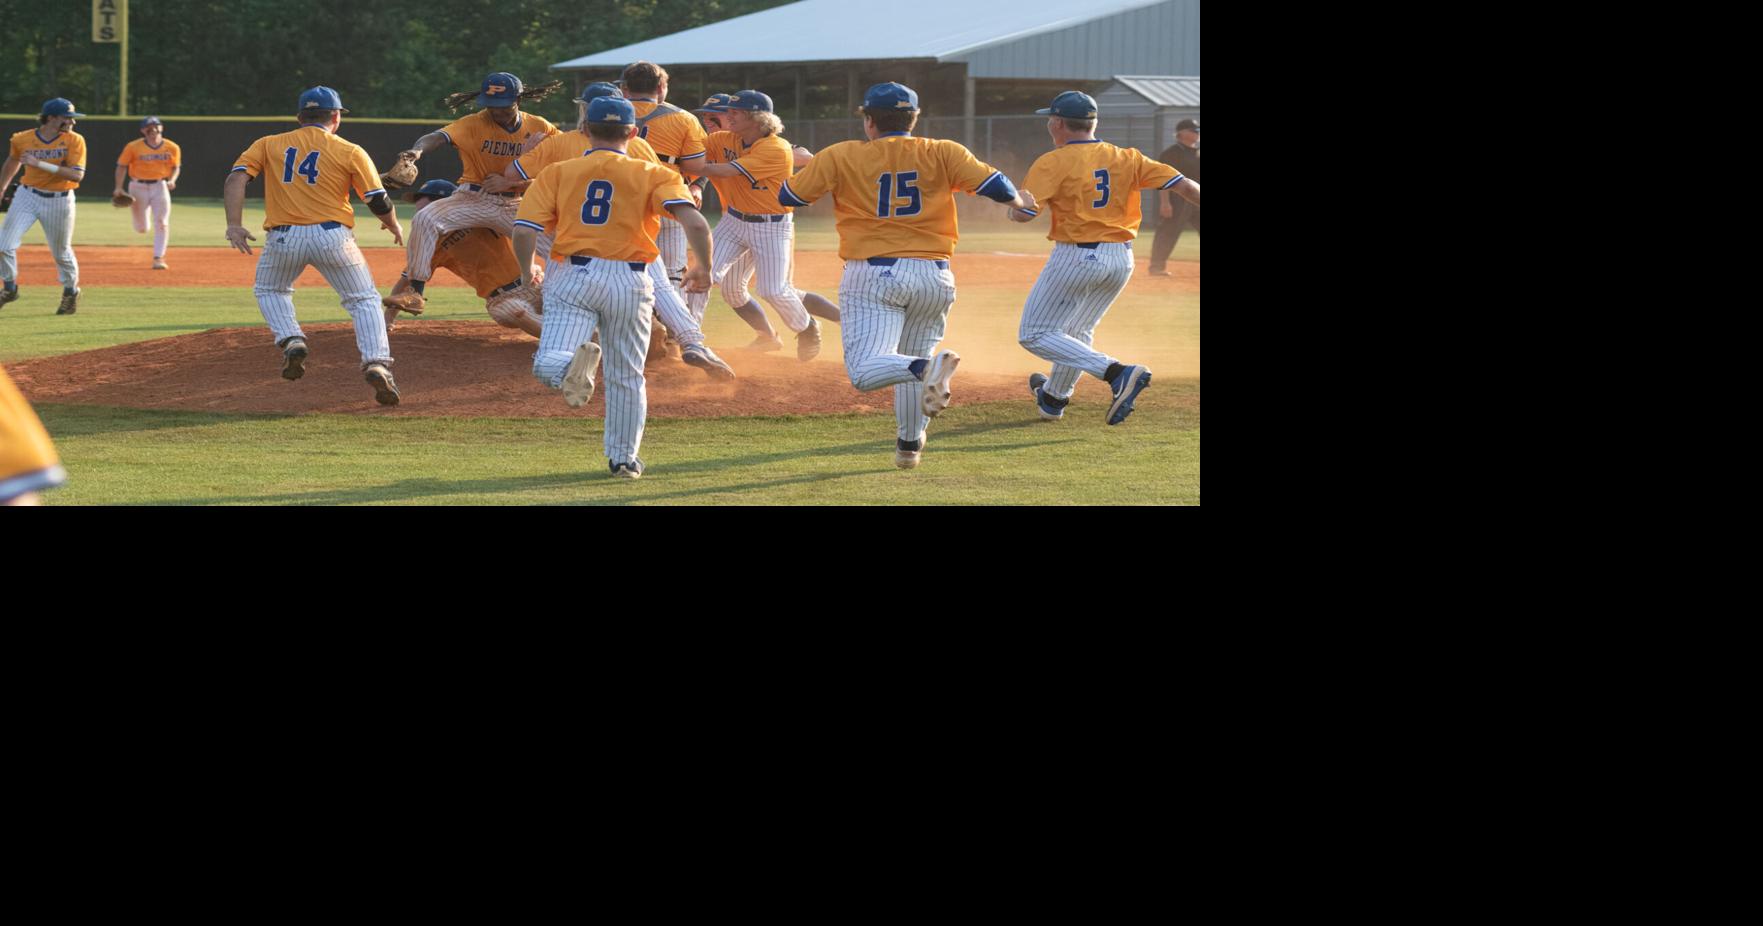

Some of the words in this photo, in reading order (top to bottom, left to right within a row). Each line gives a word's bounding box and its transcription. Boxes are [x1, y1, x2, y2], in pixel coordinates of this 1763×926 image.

[486, 85, 506, 95] P
[282, 145, 320, 185] 14
[480, 139, 524, 156] PIEDMO
[580, 179, 614, 225] 8
[877, 170, 922, 217] 15
[1092, 168, 1110, 208] 3
